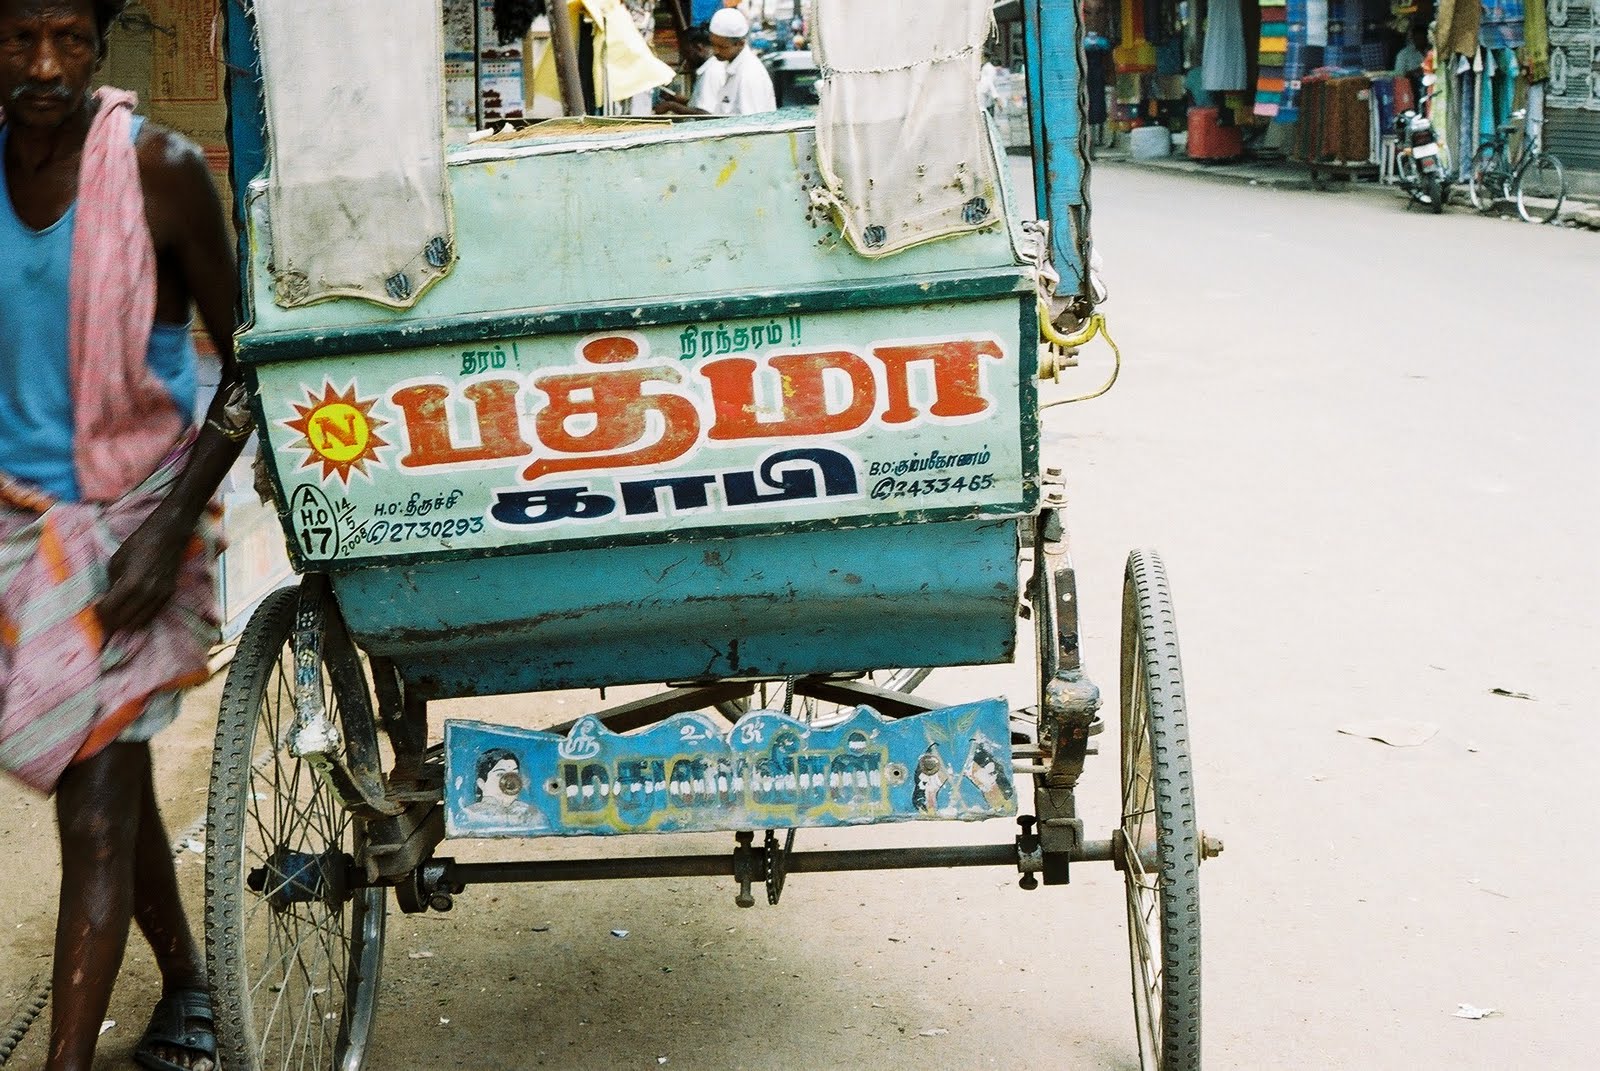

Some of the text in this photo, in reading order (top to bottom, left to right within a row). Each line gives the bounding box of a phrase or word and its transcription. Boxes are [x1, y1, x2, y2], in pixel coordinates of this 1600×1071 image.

[391, 336, 1003, 481] பத்மா
[315, 414, 358, 449] N
[302, 488, 318, 507] A
[404, 489, 464, 517] திருச்சி
[302, 527, 333, 555] 17
